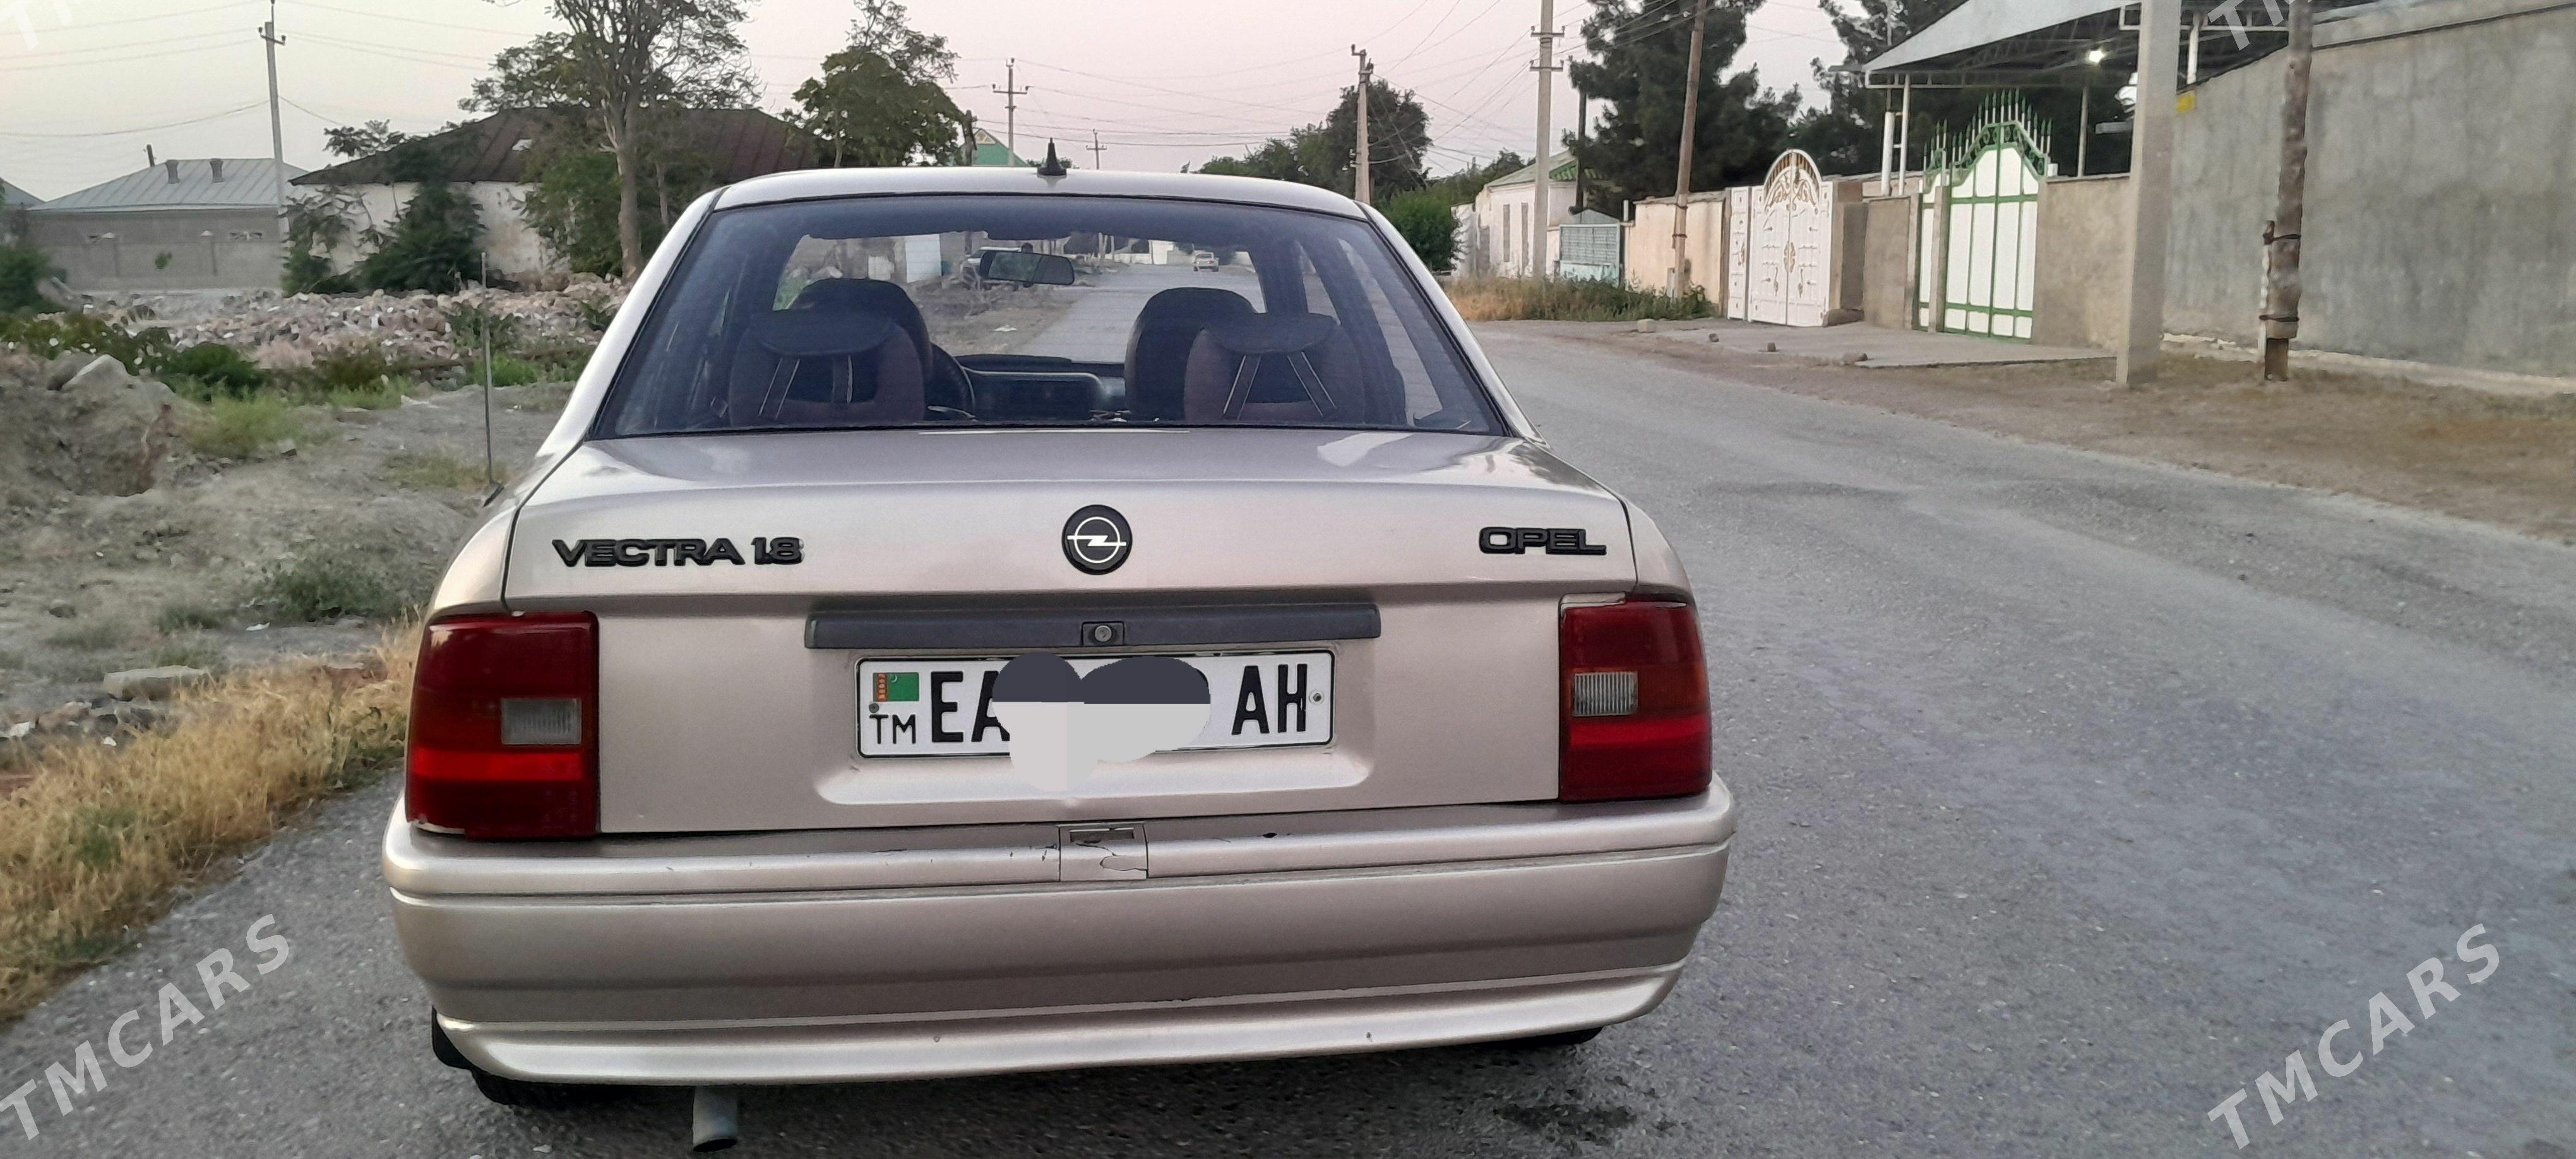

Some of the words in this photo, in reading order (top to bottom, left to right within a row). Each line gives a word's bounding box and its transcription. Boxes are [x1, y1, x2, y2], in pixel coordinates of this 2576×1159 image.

[552, 538, 746, 567] VECTRA
[1479, 526, 1607, 556] OPEL
[1231, 663, 1308, 735] AH
[869, 713, 916, 744] TM
